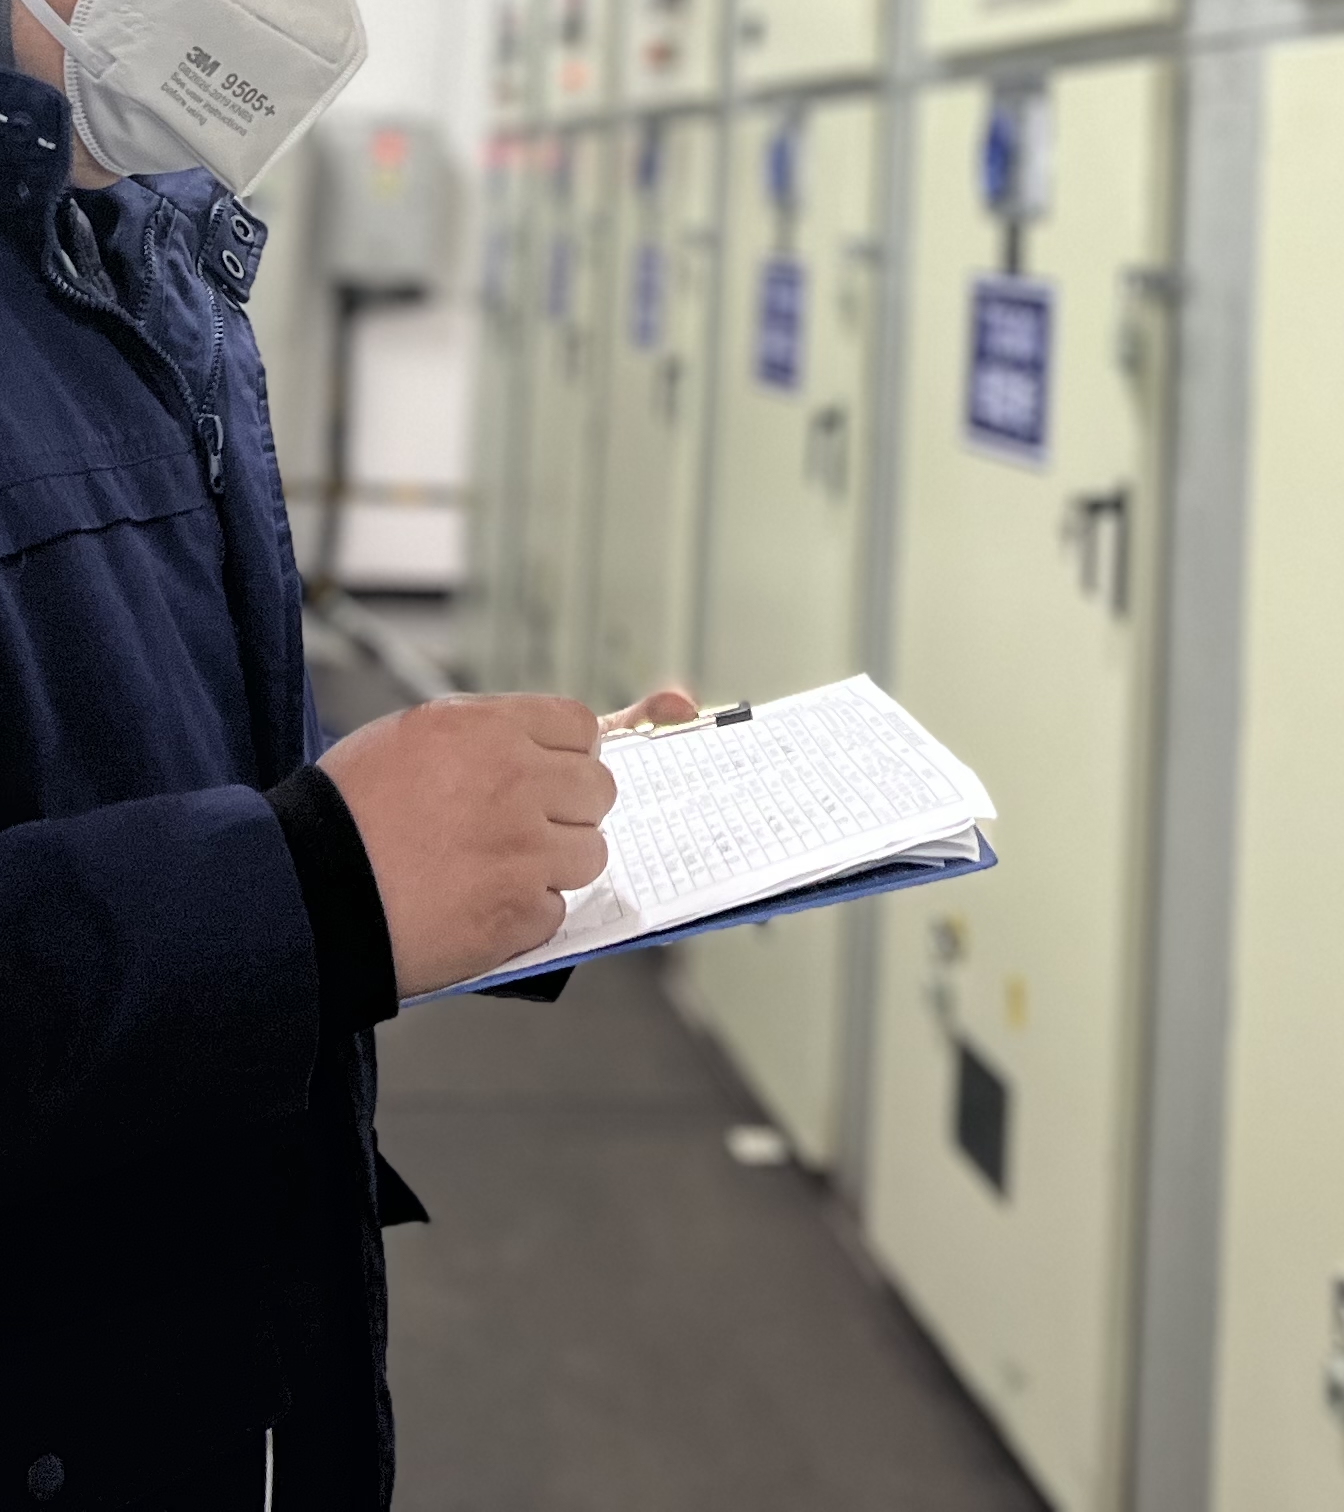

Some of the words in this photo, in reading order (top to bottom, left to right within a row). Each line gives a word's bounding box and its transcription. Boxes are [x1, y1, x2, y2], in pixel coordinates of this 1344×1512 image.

[161, 83, 186, 106] before
[187, 105, 208, 126] using
[171, 72, 186, 89] See
[185, 88, 203, 104] user
[203, 101, 247, 136] instructions
[186, 46, 221, 77] 3M
[221, 73, 275, 116] 9505+
